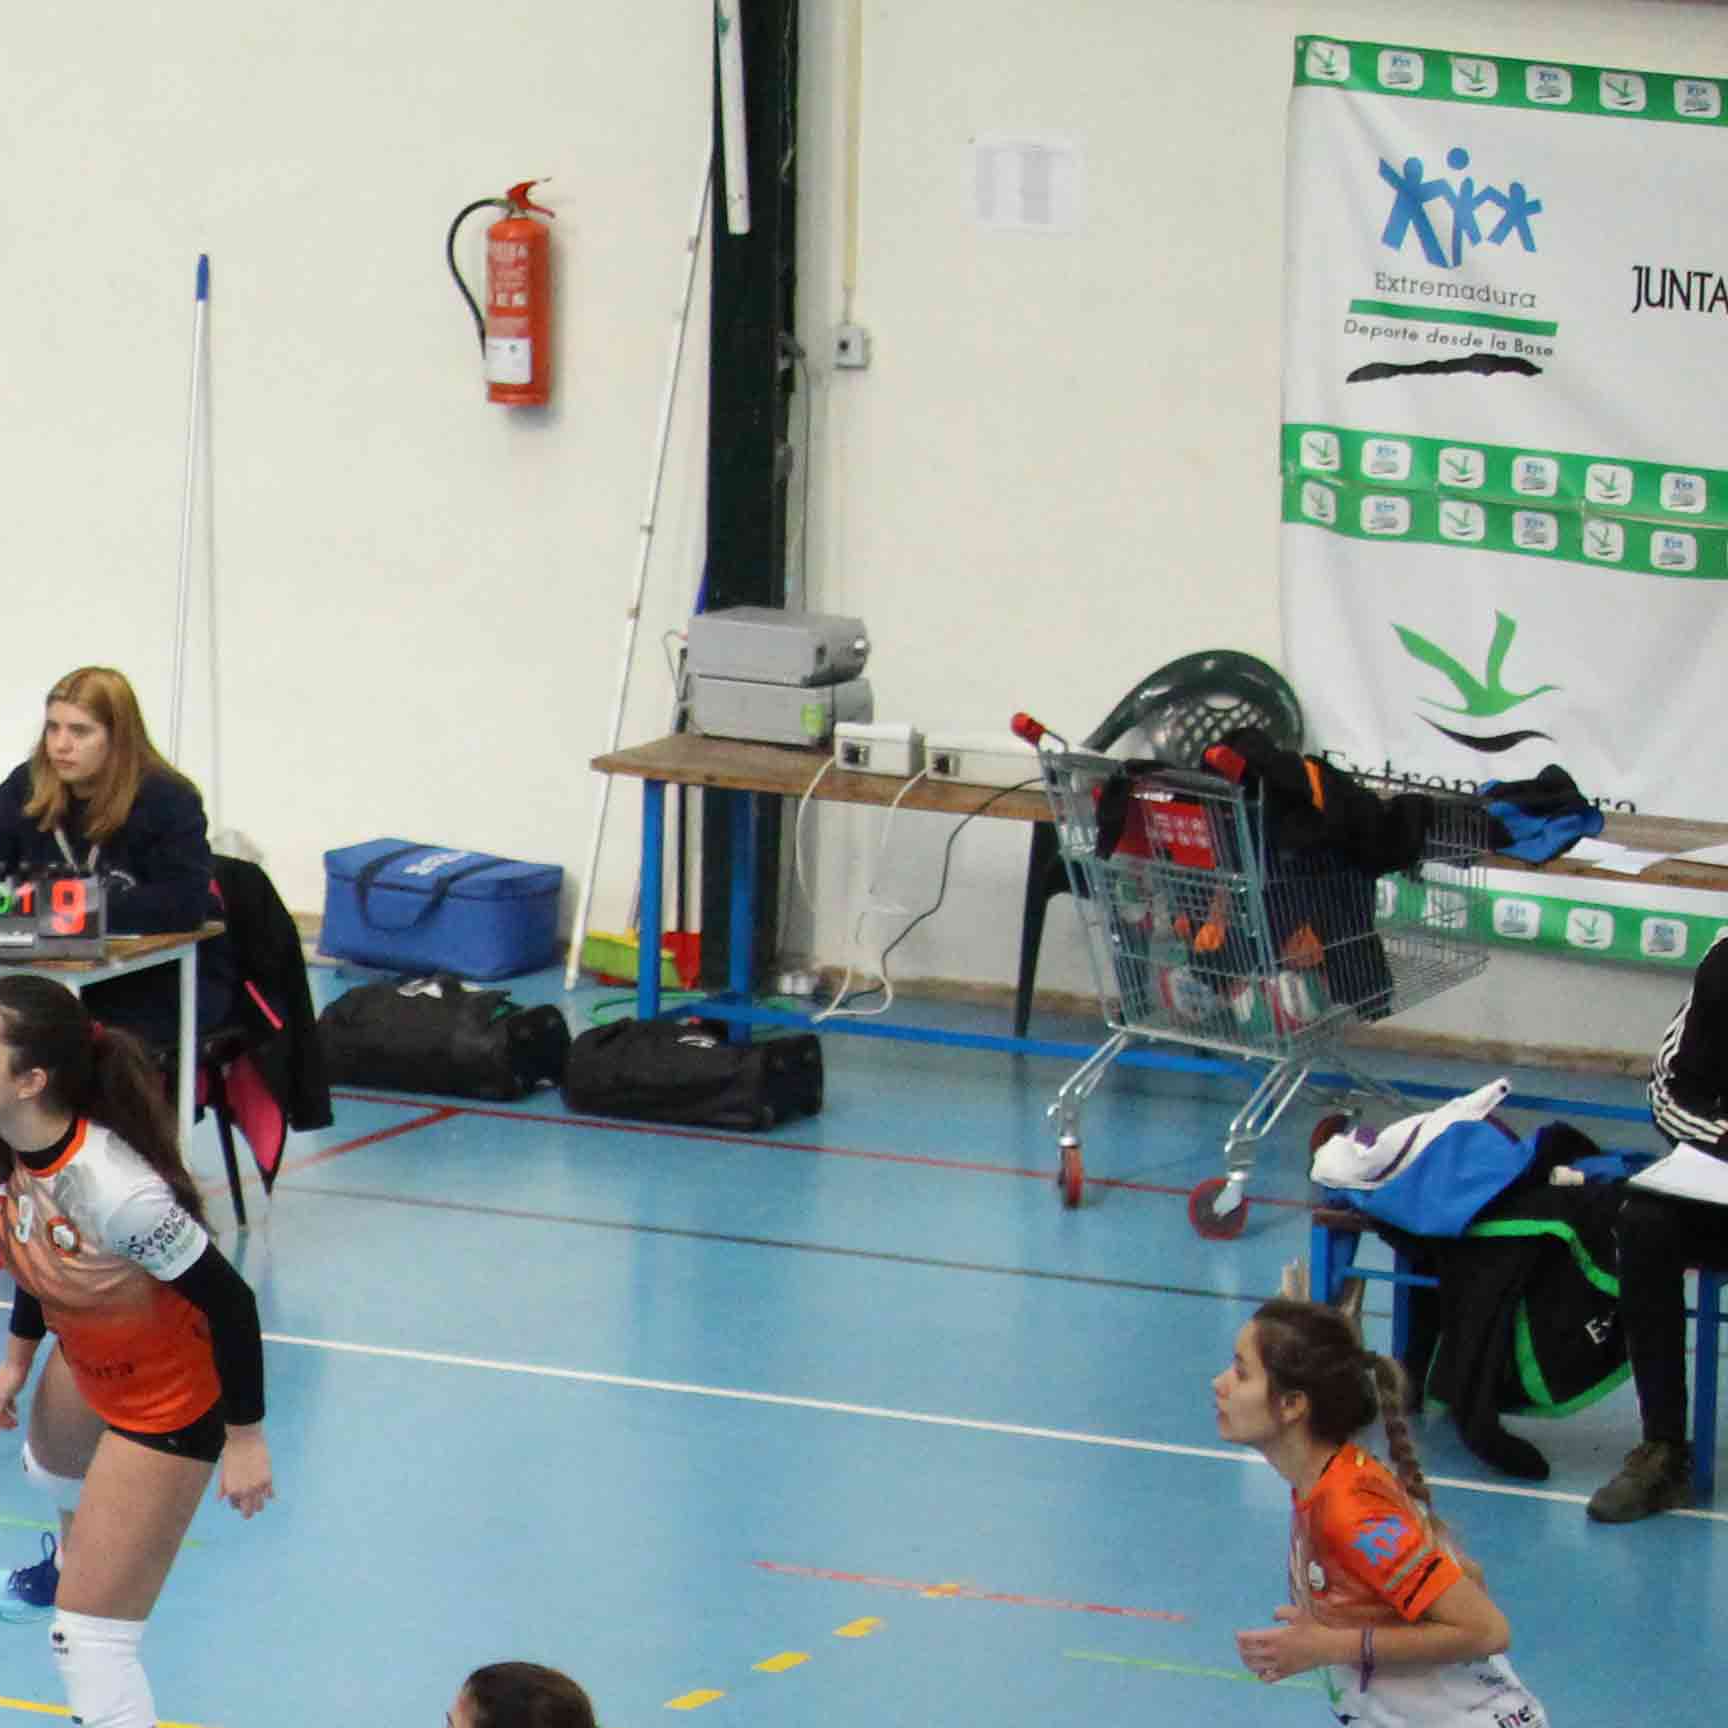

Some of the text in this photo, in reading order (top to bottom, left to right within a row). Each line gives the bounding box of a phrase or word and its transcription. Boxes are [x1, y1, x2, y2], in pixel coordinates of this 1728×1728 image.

[1374, 272, 1537, 309] Extremadura
[1631, 265, 1728, 314] JUNTA
[1344, 319, 1554, 358] Deporte desde la Base
[51, 880, 86, 935] 9
